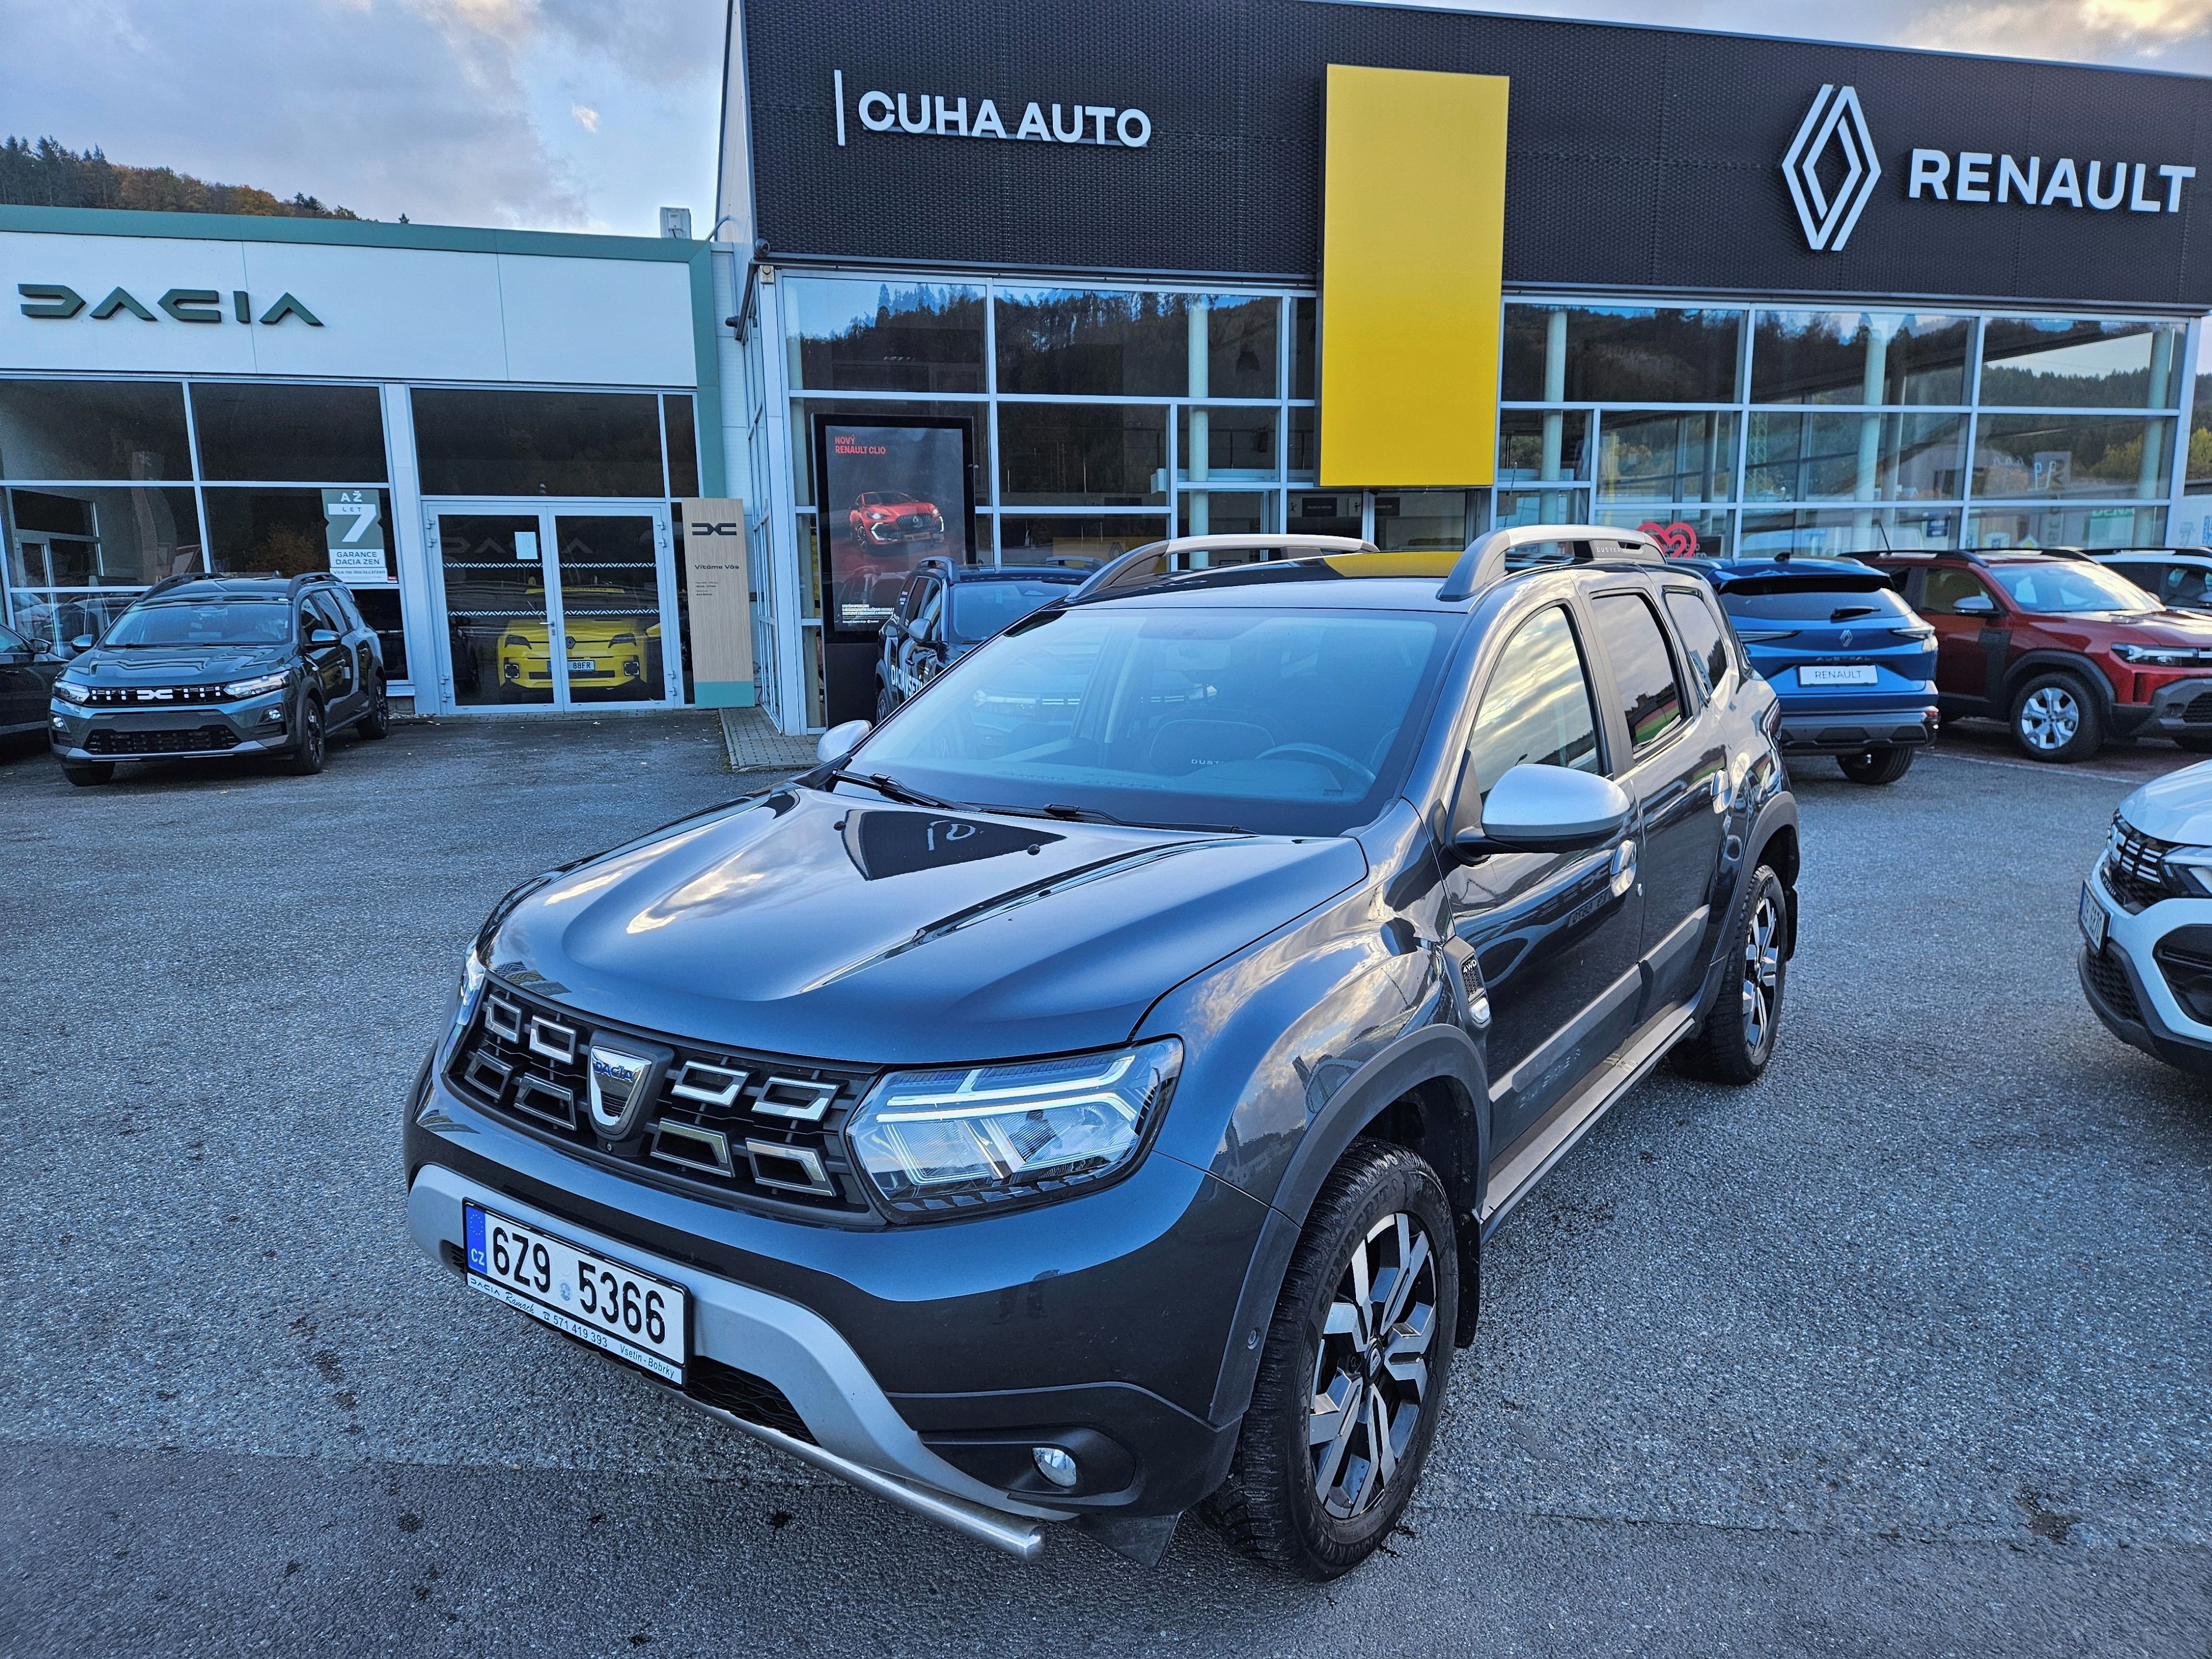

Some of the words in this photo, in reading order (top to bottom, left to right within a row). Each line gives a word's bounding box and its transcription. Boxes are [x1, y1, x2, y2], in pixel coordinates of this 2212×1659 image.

[858, 90, 1008, 139] CUHA
[1016, 102, 1152, 148] AUTO
[1908, 148, 2197, 213] RENAULT
[17, 283, 325, 328] DACIA
[834, 434, 855, 444] NOVÝ
[835, 445, 868, 454] RENAULT
[869, 446, 886, 455] CLIO
[340, 490, 363, 503] AŽ
[327, 503, 377, 543] 7
[1815, 670, 1862, 679] RENAULT
[1463, 958, 1477, 974] 4WD
[594, 1061, 634, 1080] DACIA
[471, 1248, 486, 1266] CZ
[1317, 1184, 1390, 1316] SEMPERIT
[471, 1278, 500, 1296] DACIA
[493, 1227, 551, 1293] 6Z9
[578, 1259, 666, 1344] 5366
[554, 1315, 568, 1330] 571
[572, 1324, 588, 1339] 419
[591, 1332, 608, 1348] 393
[620, 1344, 642, 1362] Vsetín
[648, 1357, 675, 1379] Bobrky
